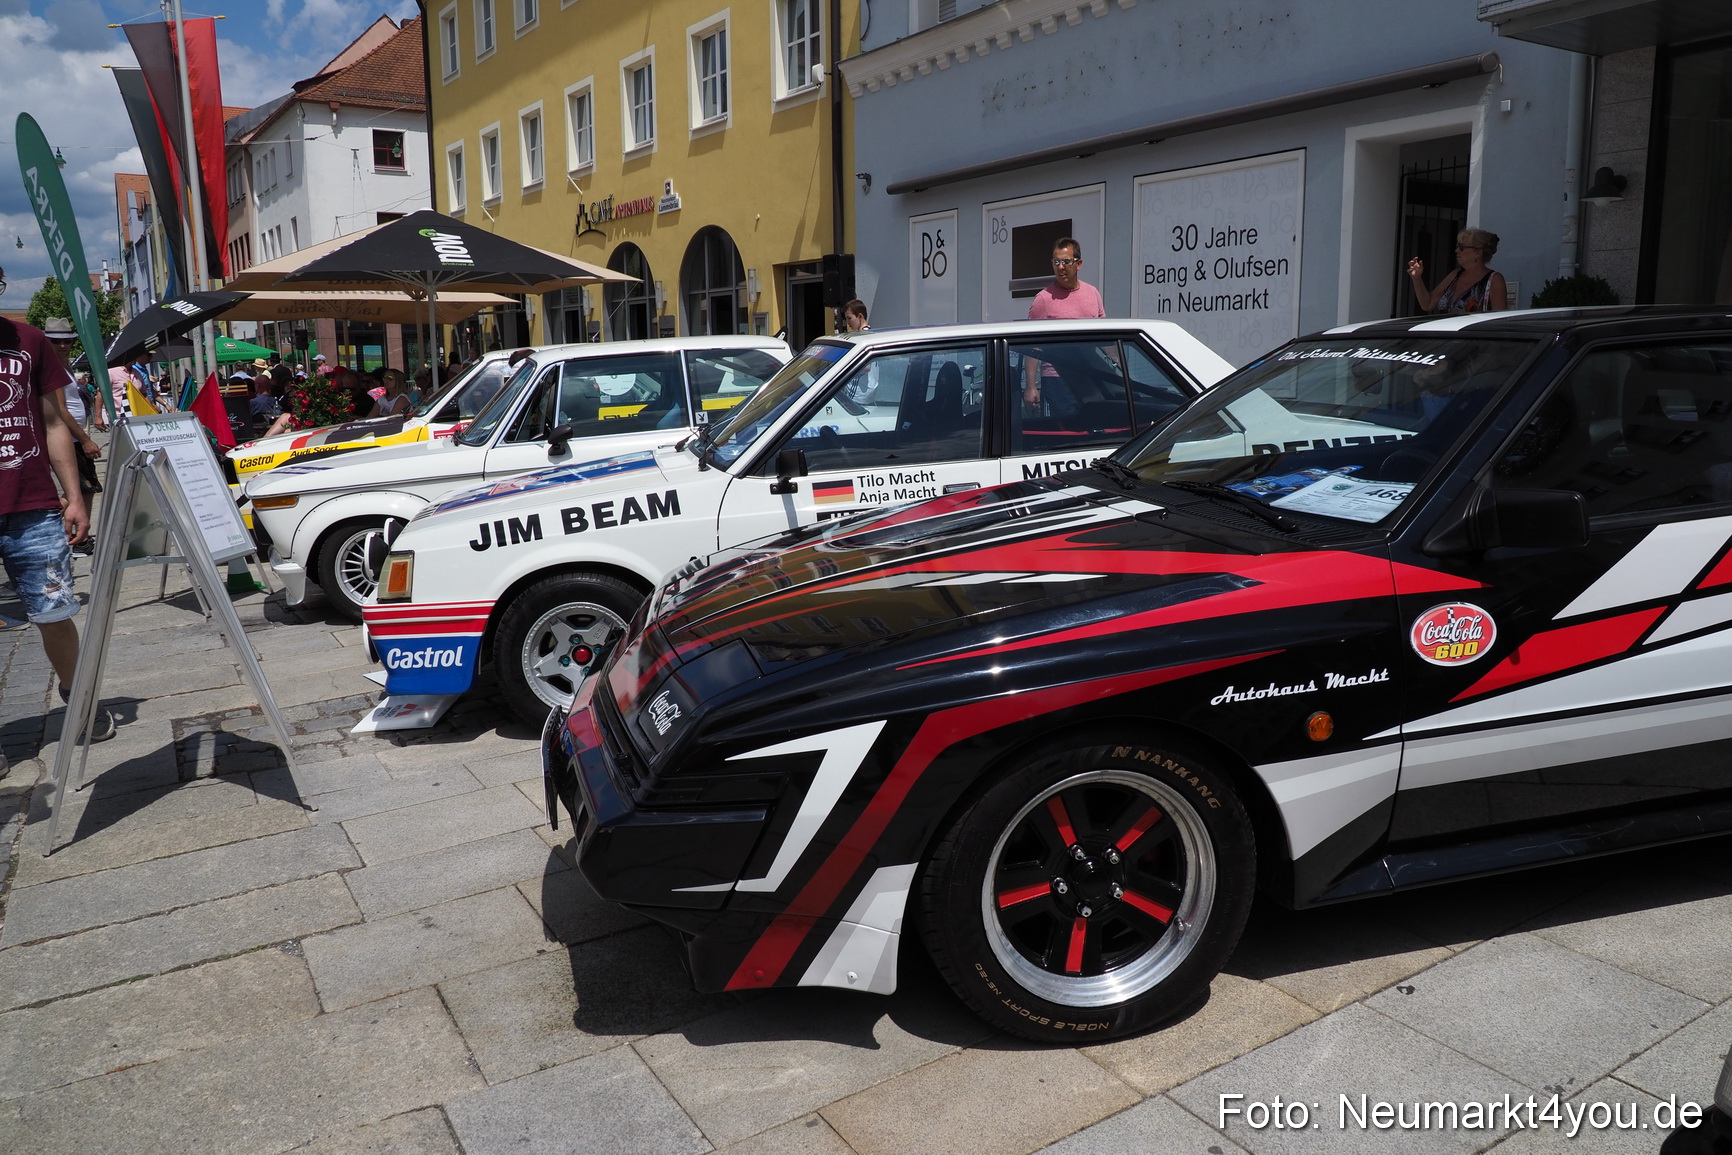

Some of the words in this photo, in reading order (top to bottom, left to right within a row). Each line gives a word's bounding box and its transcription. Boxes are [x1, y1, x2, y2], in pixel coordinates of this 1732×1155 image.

[1171, 223, 1198, 252] 30
[1204, 225, 1258, 249] Jahre
[1144, 264, 1187, 287] Bang
[1194, 260, 1206, 281] &
[1214, 255, 1288, 279] Olufsen
[1157, 293, 1171, 313] in
[1178, 288, 1269, 312] Neumarkt
[1278, 351, 1300, 361] Old
[1300, 349, 1353, 360] School
[1350, 347, 1446, 366] Mitsubishi
[155, 421, 180, 432] DEKRA
[137, 432, 197, 446] RENNFAHRZEUGSCHAU
[289, 447, 311, 458] Audi
[313, 445, 339, 454] Sport
[240, 455, 274, 469] Castrol
[857, 475, 884, 488] Tilo
[889, 471, 935, 485] Macht
[859, 490, 889, 504] Anja
[894, 486, 937, 500] Macht
[1364, 488, 1410, 501] 468
[469, 513, 543, 552] JIM
[560, 489, 682, 535] BEAM
[386, 645, 463, 669] Castrol
[1435, 641, 1479, 660] 600
[1210, 680, 1318, 706] Autohaus
[1324, 668, 1389, 689] Macht
[1133, 750, 1222, 809] NANKANG
[974, 962, 1002, 996] NS-20
[1001, 998, 1050, 1026] SPORT
[1054, 1021, 1110, 1031] NOBLE
